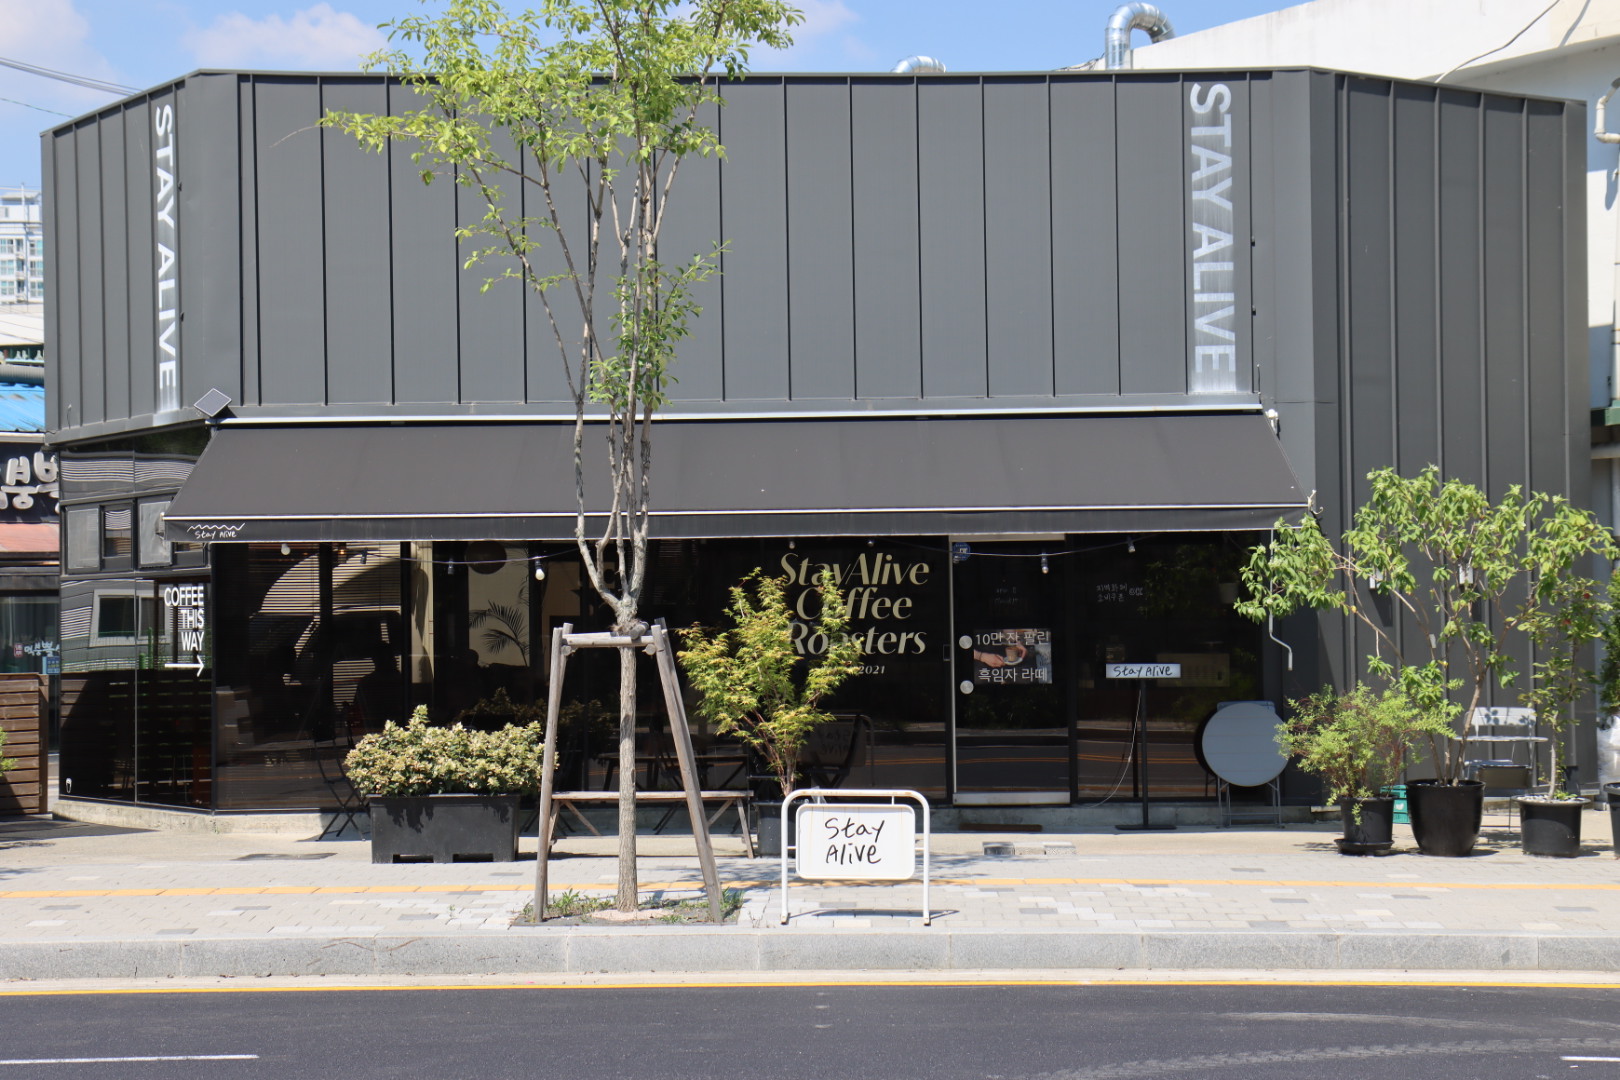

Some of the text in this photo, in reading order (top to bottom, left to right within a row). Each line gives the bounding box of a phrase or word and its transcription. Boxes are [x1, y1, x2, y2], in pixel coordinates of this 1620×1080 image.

[1190, 83, 1235, 373] STAY ALIVE
[155, 104, 176, 389] STAY ALIVE
[195, 530, 216, 540] Stay
[164, 586, 204, 607] COFFEE
[796, 587, 912, 620] Cffee
[181, 608, 204, 629] THIS
[181, 631, 204, 652] WAY
[976, 631, 1049, 646] 10만 잔 팔린
[858, 665, 885, 674] 2021
[978, 667, 1048, 682] 흑임자 라떼
[1113, 665, 1173, 678] Stay Alive
[824, 816, 885, 843] Stay
[825, 842, 882, 865] Alive
